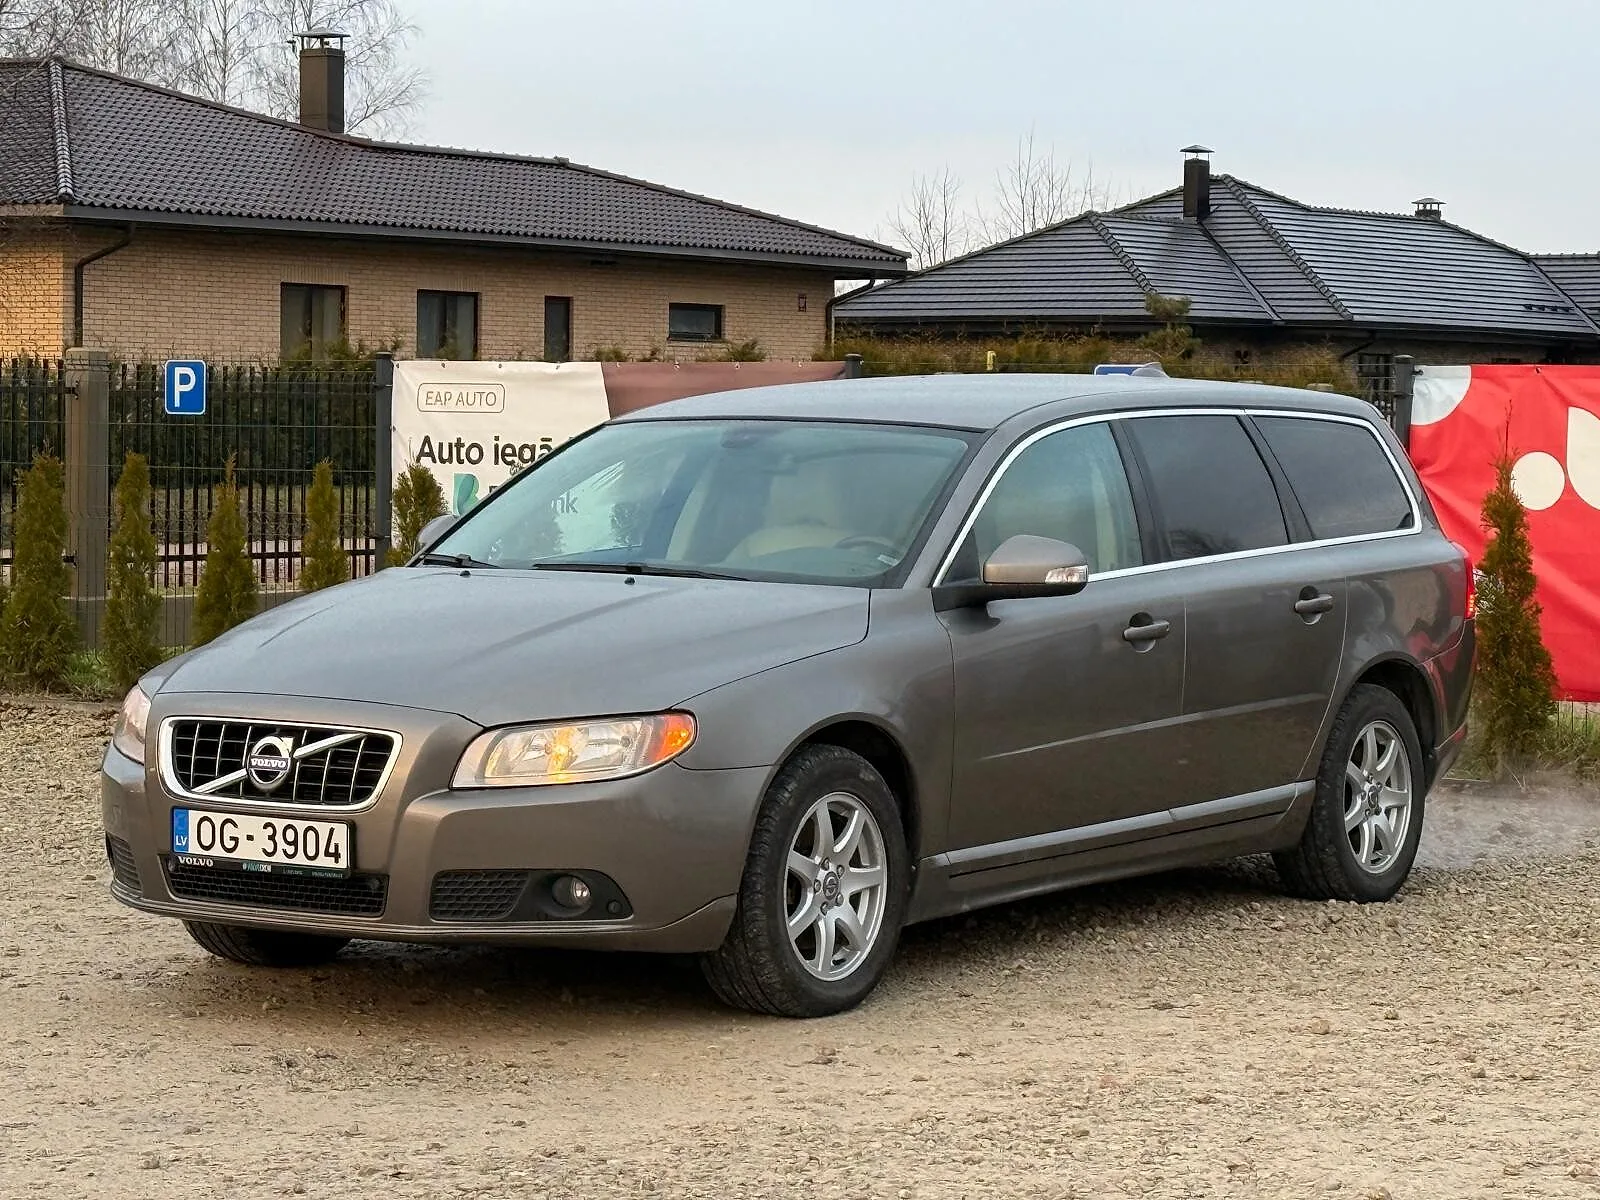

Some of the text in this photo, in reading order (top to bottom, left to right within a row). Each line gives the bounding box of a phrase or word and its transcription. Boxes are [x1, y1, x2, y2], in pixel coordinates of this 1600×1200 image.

[174, 367, 196, 408] P
[425, 391, 497, 407] EAP AUTO
[416, 435, 485, 466] Auto
[250, 758, 287, 769] VOLVO
[175, 834, 188, 847] LV
[196, 815, 342, 864] OG-3904
[178, 855, 214, 867] VOLVO
